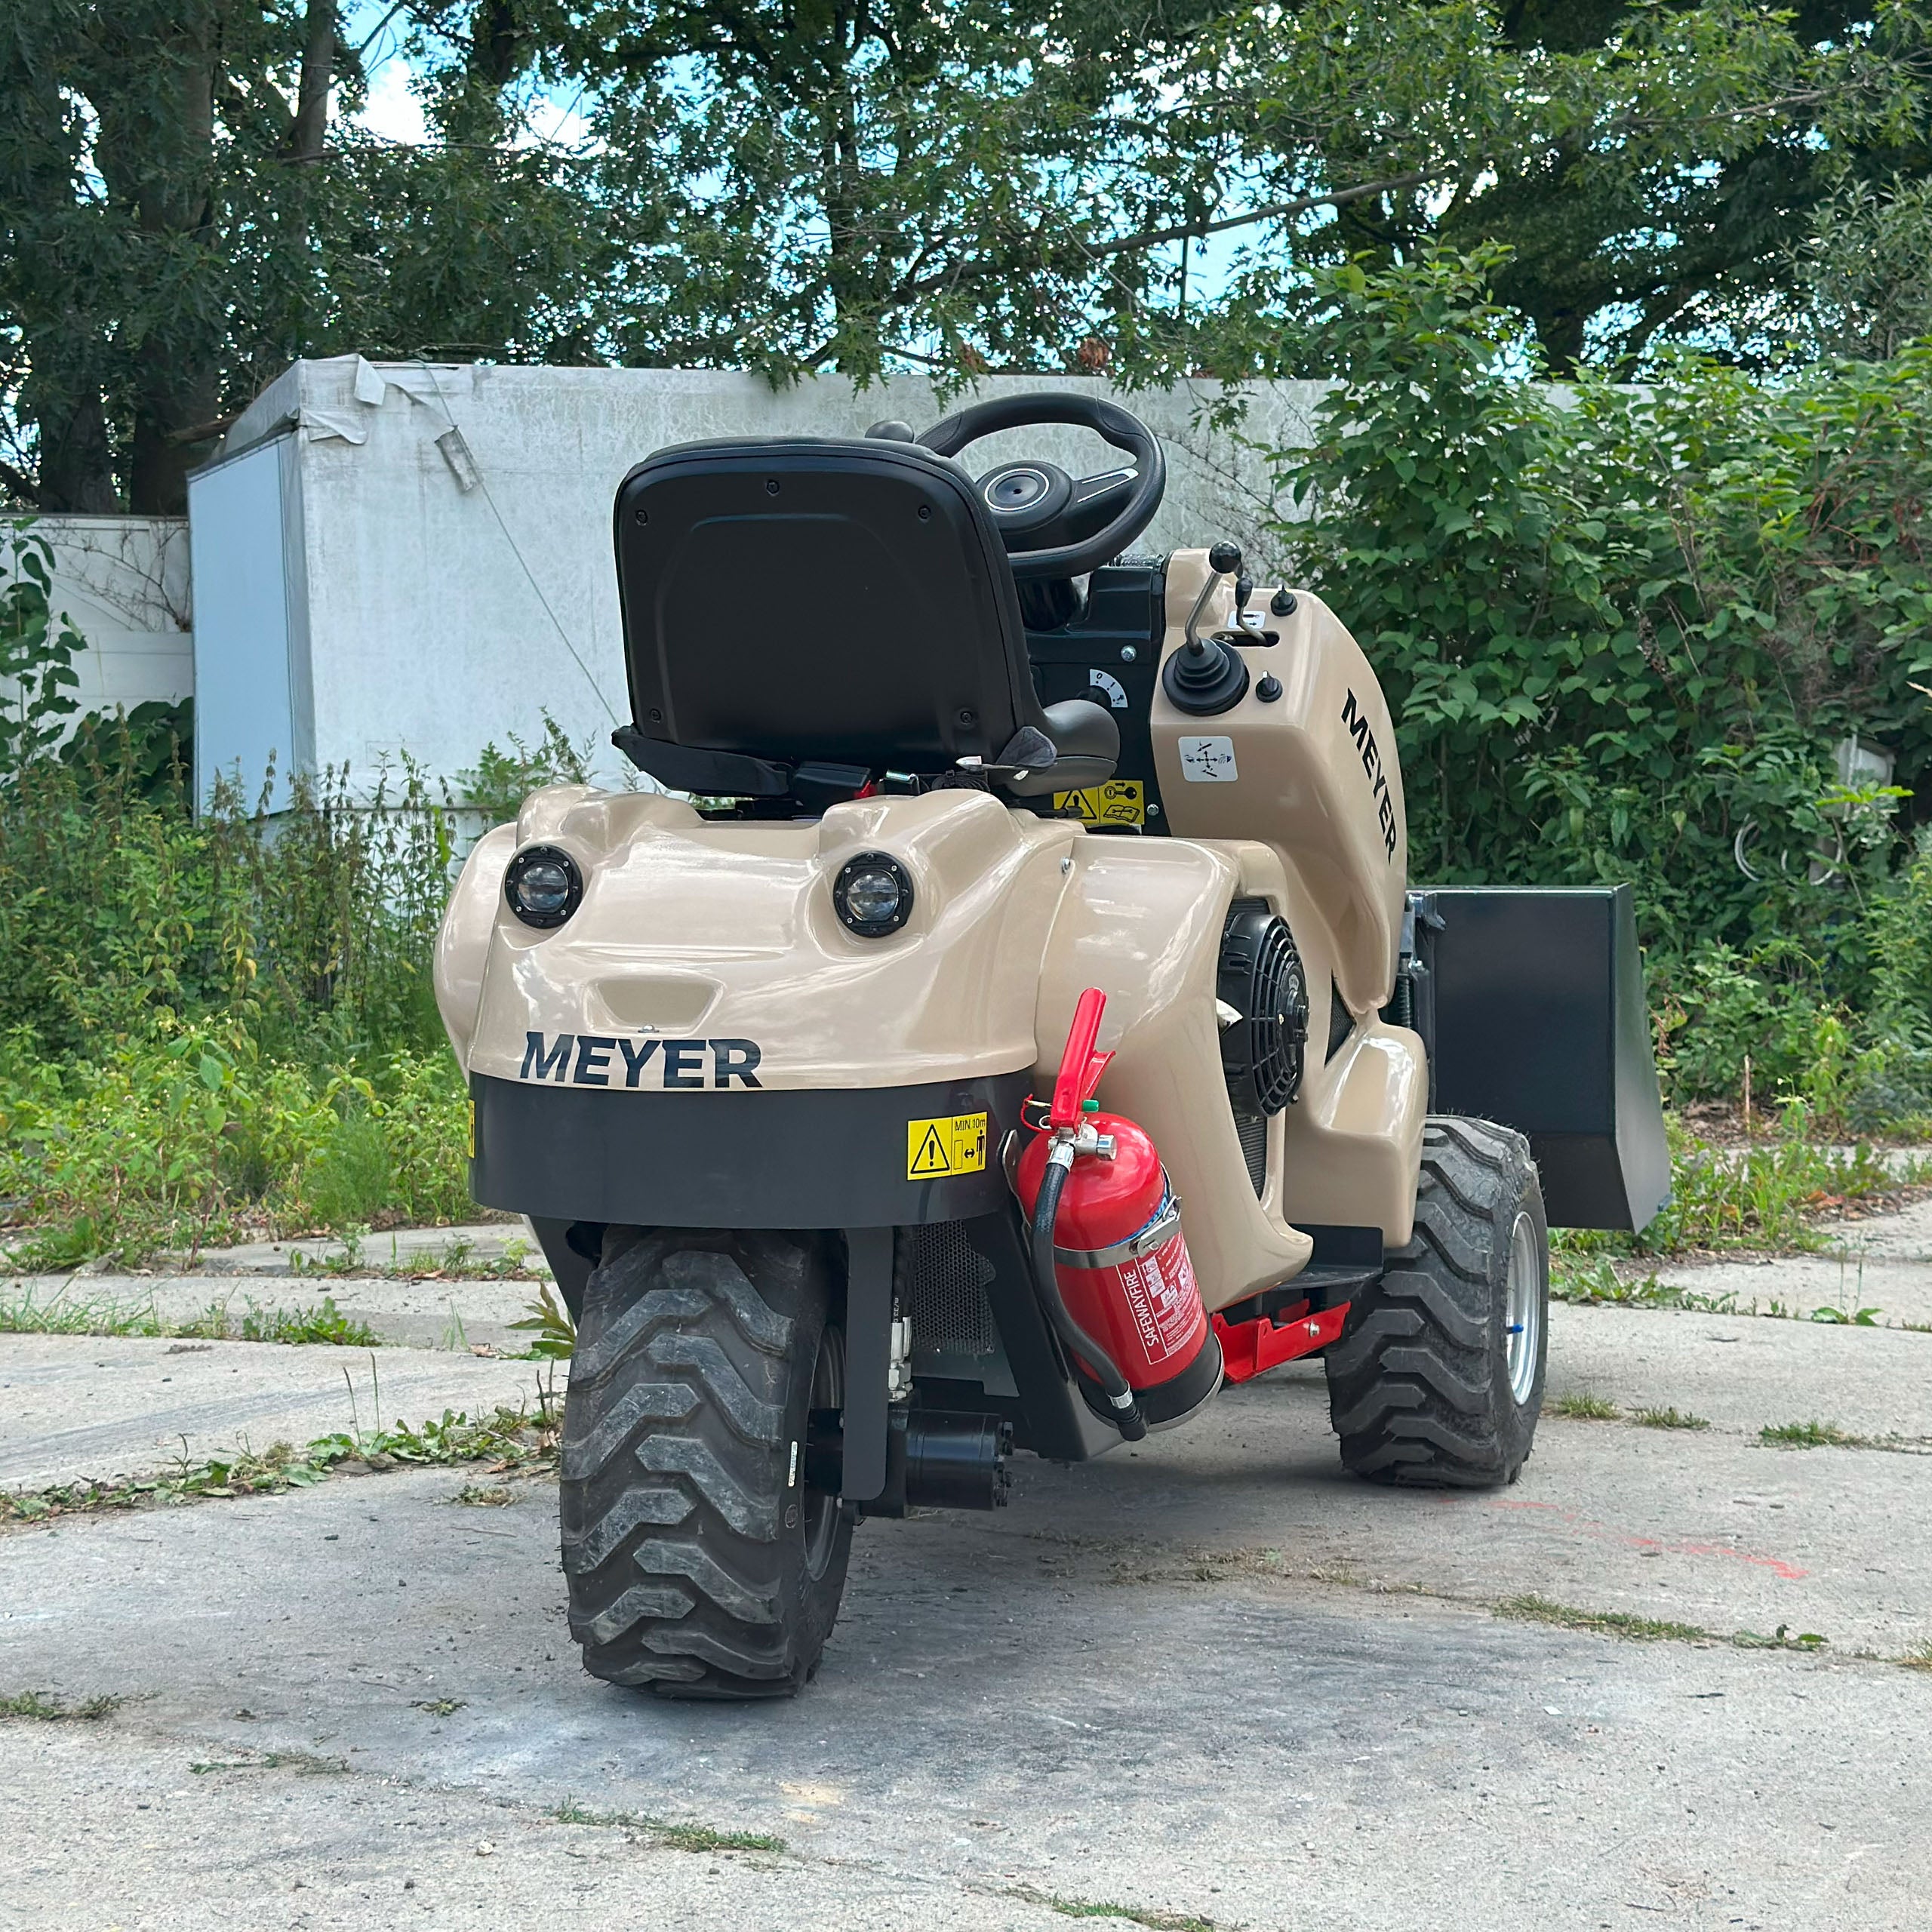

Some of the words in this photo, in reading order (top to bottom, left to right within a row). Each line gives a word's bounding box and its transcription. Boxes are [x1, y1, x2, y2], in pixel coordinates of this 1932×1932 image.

[1341, 688, 1396, 866] MEYER
[520, 1031, 762, 1088] MEYER
[1124, 1269, 1159, 1347] SAFEWAYFIRE
